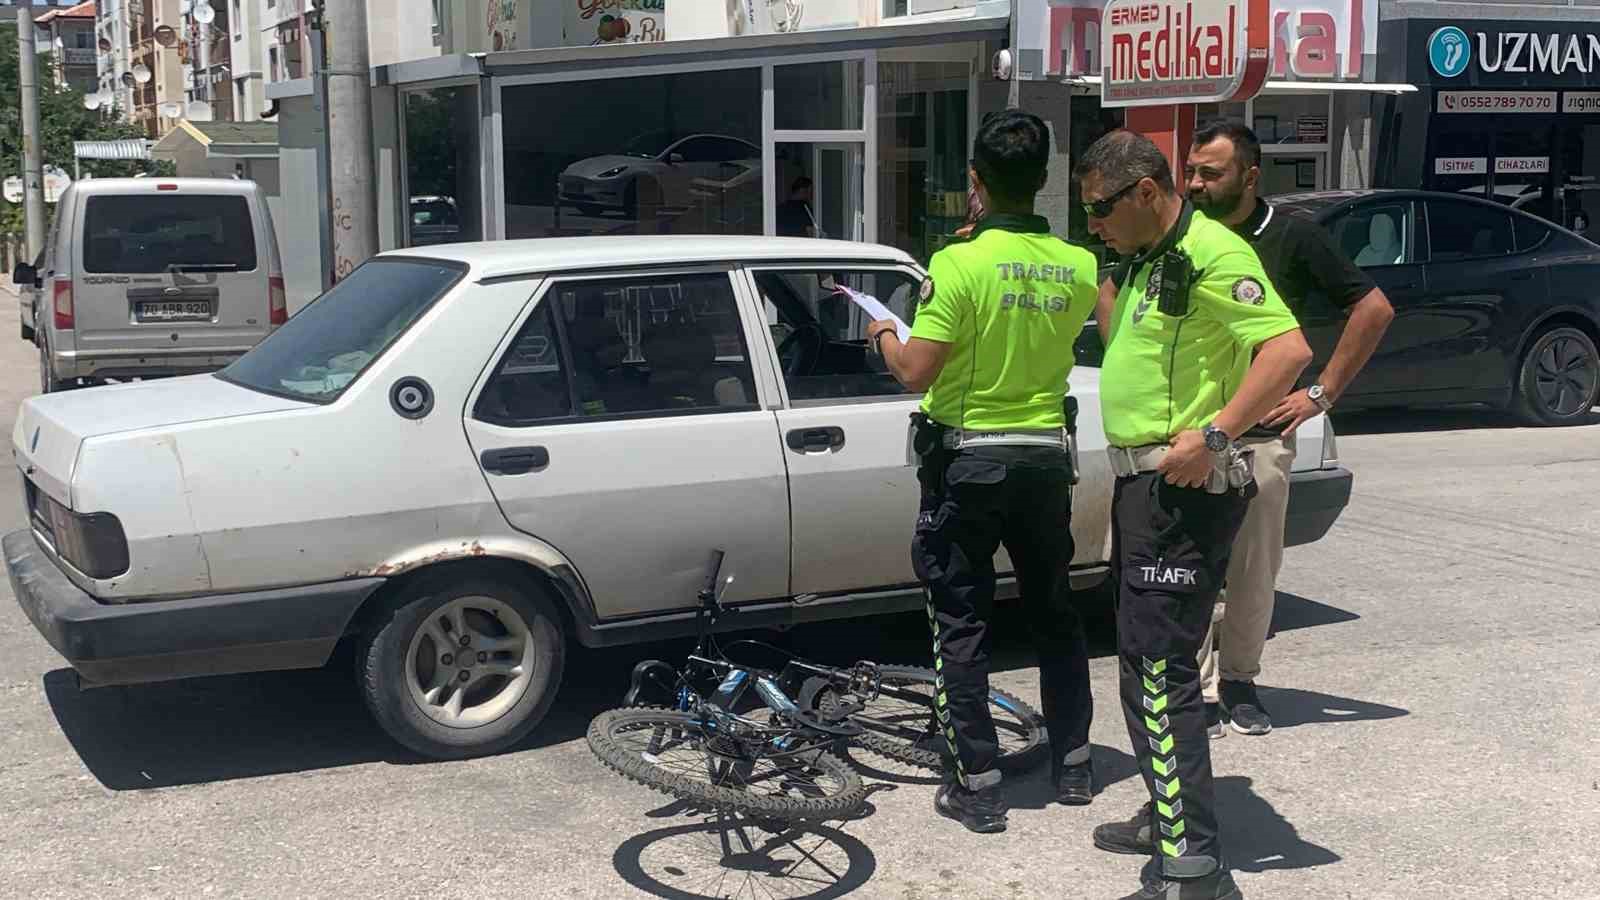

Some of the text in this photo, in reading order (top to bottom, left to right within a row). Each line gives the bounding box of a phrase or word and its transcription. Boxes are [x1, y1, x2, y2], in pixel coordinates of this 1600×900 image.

[1111, 5, 1160, 25] ERMED
[1112, 2, 1236, 81] medikal
[1476, 32, 1600, 74] UZMAN
[1461, 96, 1551, 108] 0552 789 70 70
[186, 303, 209, 314] 920
